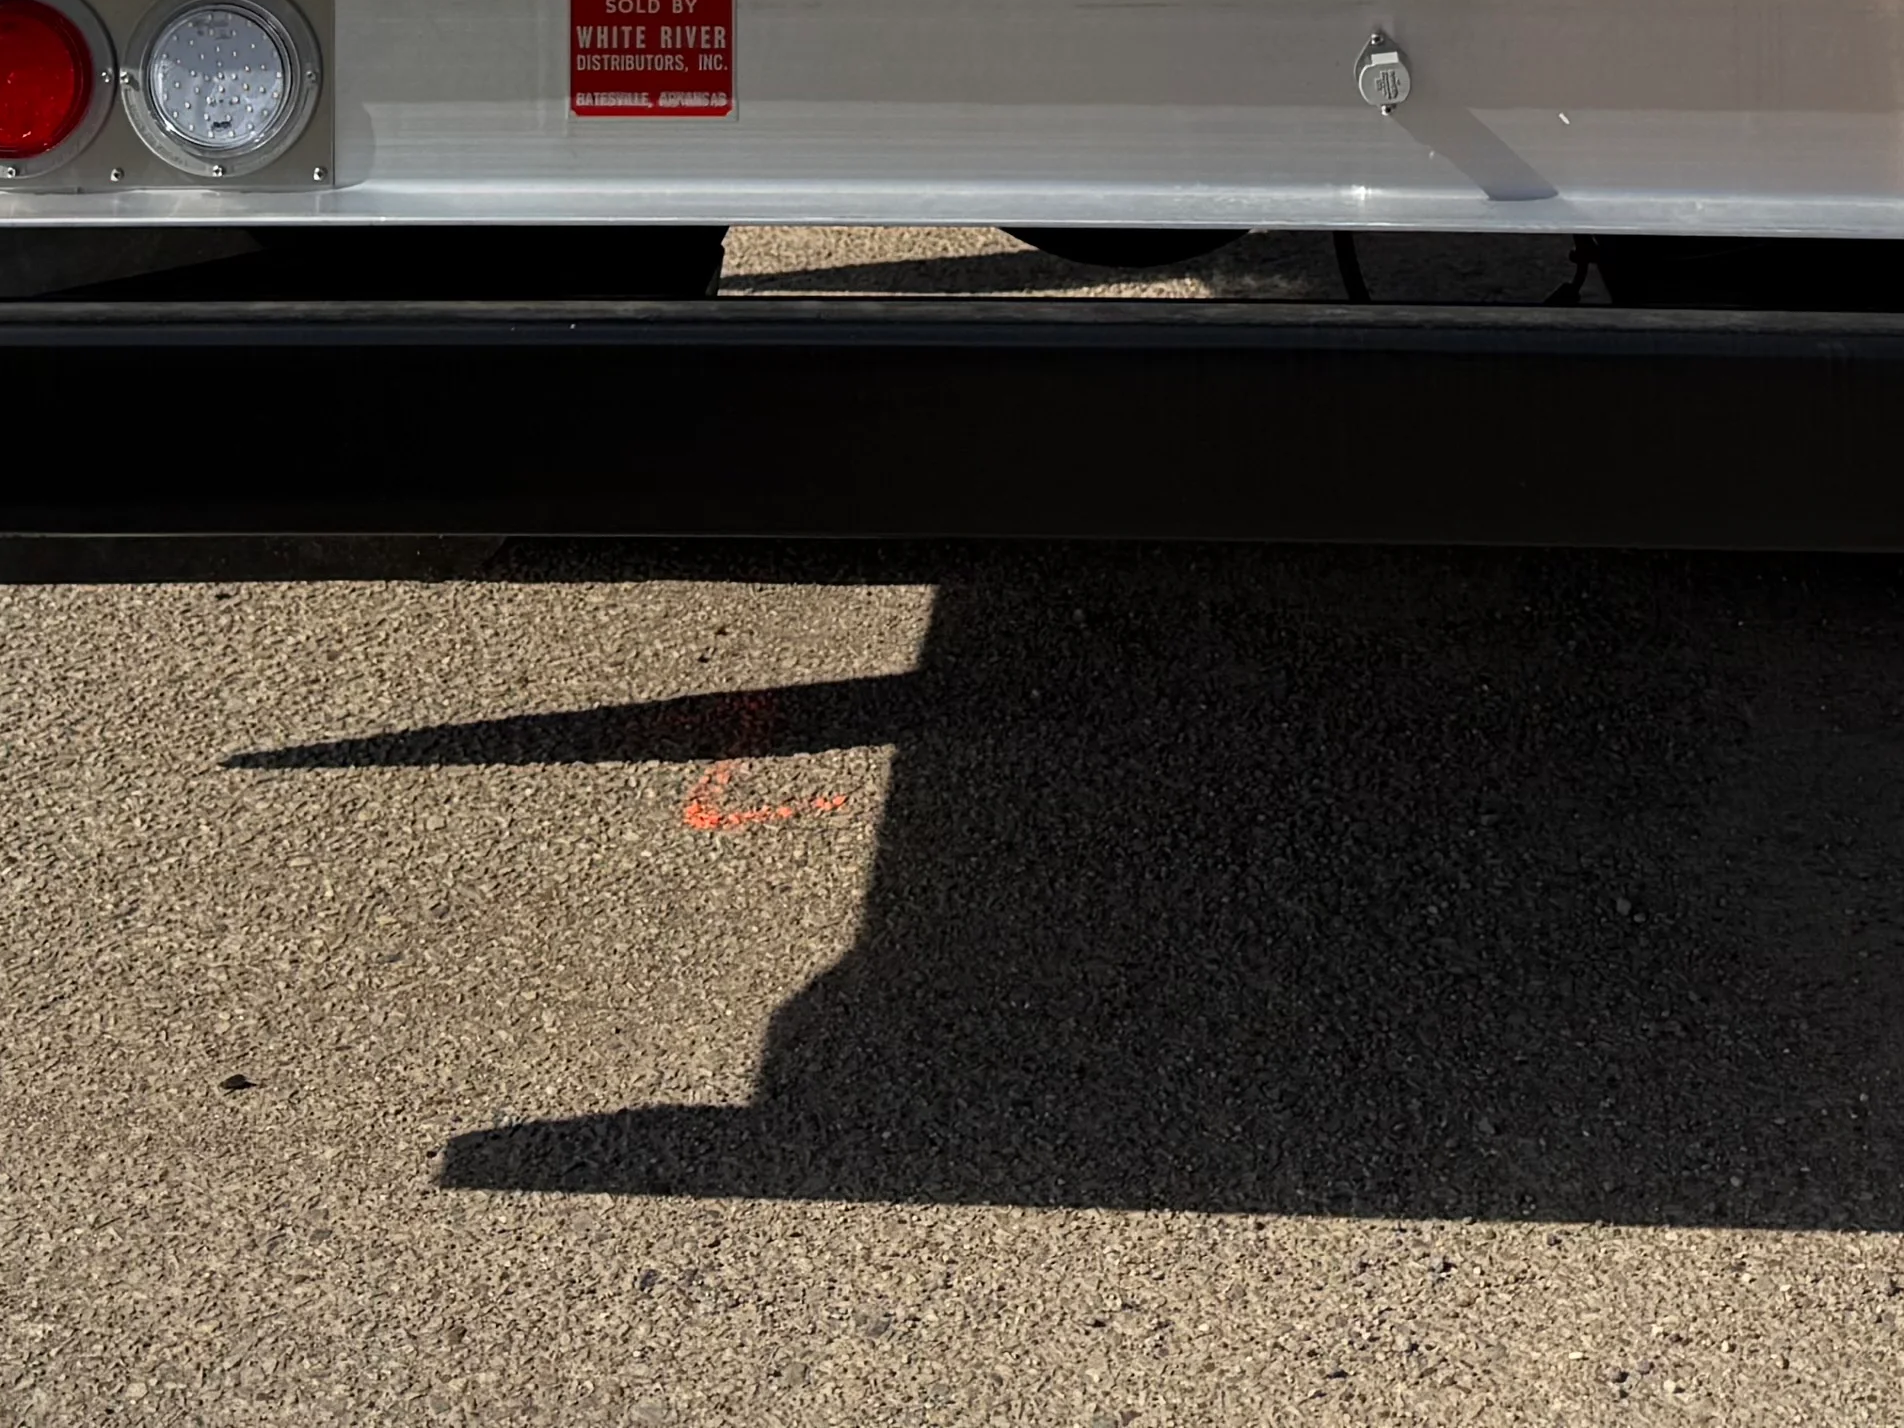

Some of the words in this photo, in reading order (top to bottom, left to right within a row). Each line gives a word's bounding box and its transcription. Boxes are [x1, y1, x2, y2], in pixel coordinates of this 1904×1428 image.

[576, 25, 646, 49] WHITE
[660, 25, 727, 49] RIVER
[576, 54, 689, 73] DISTRIBUTORS,
[698, 53, 729, 71] INC.
[576, 92, 653, 108] BATESVILLE,
[658, 91, 728, 108] ARKANSAS
